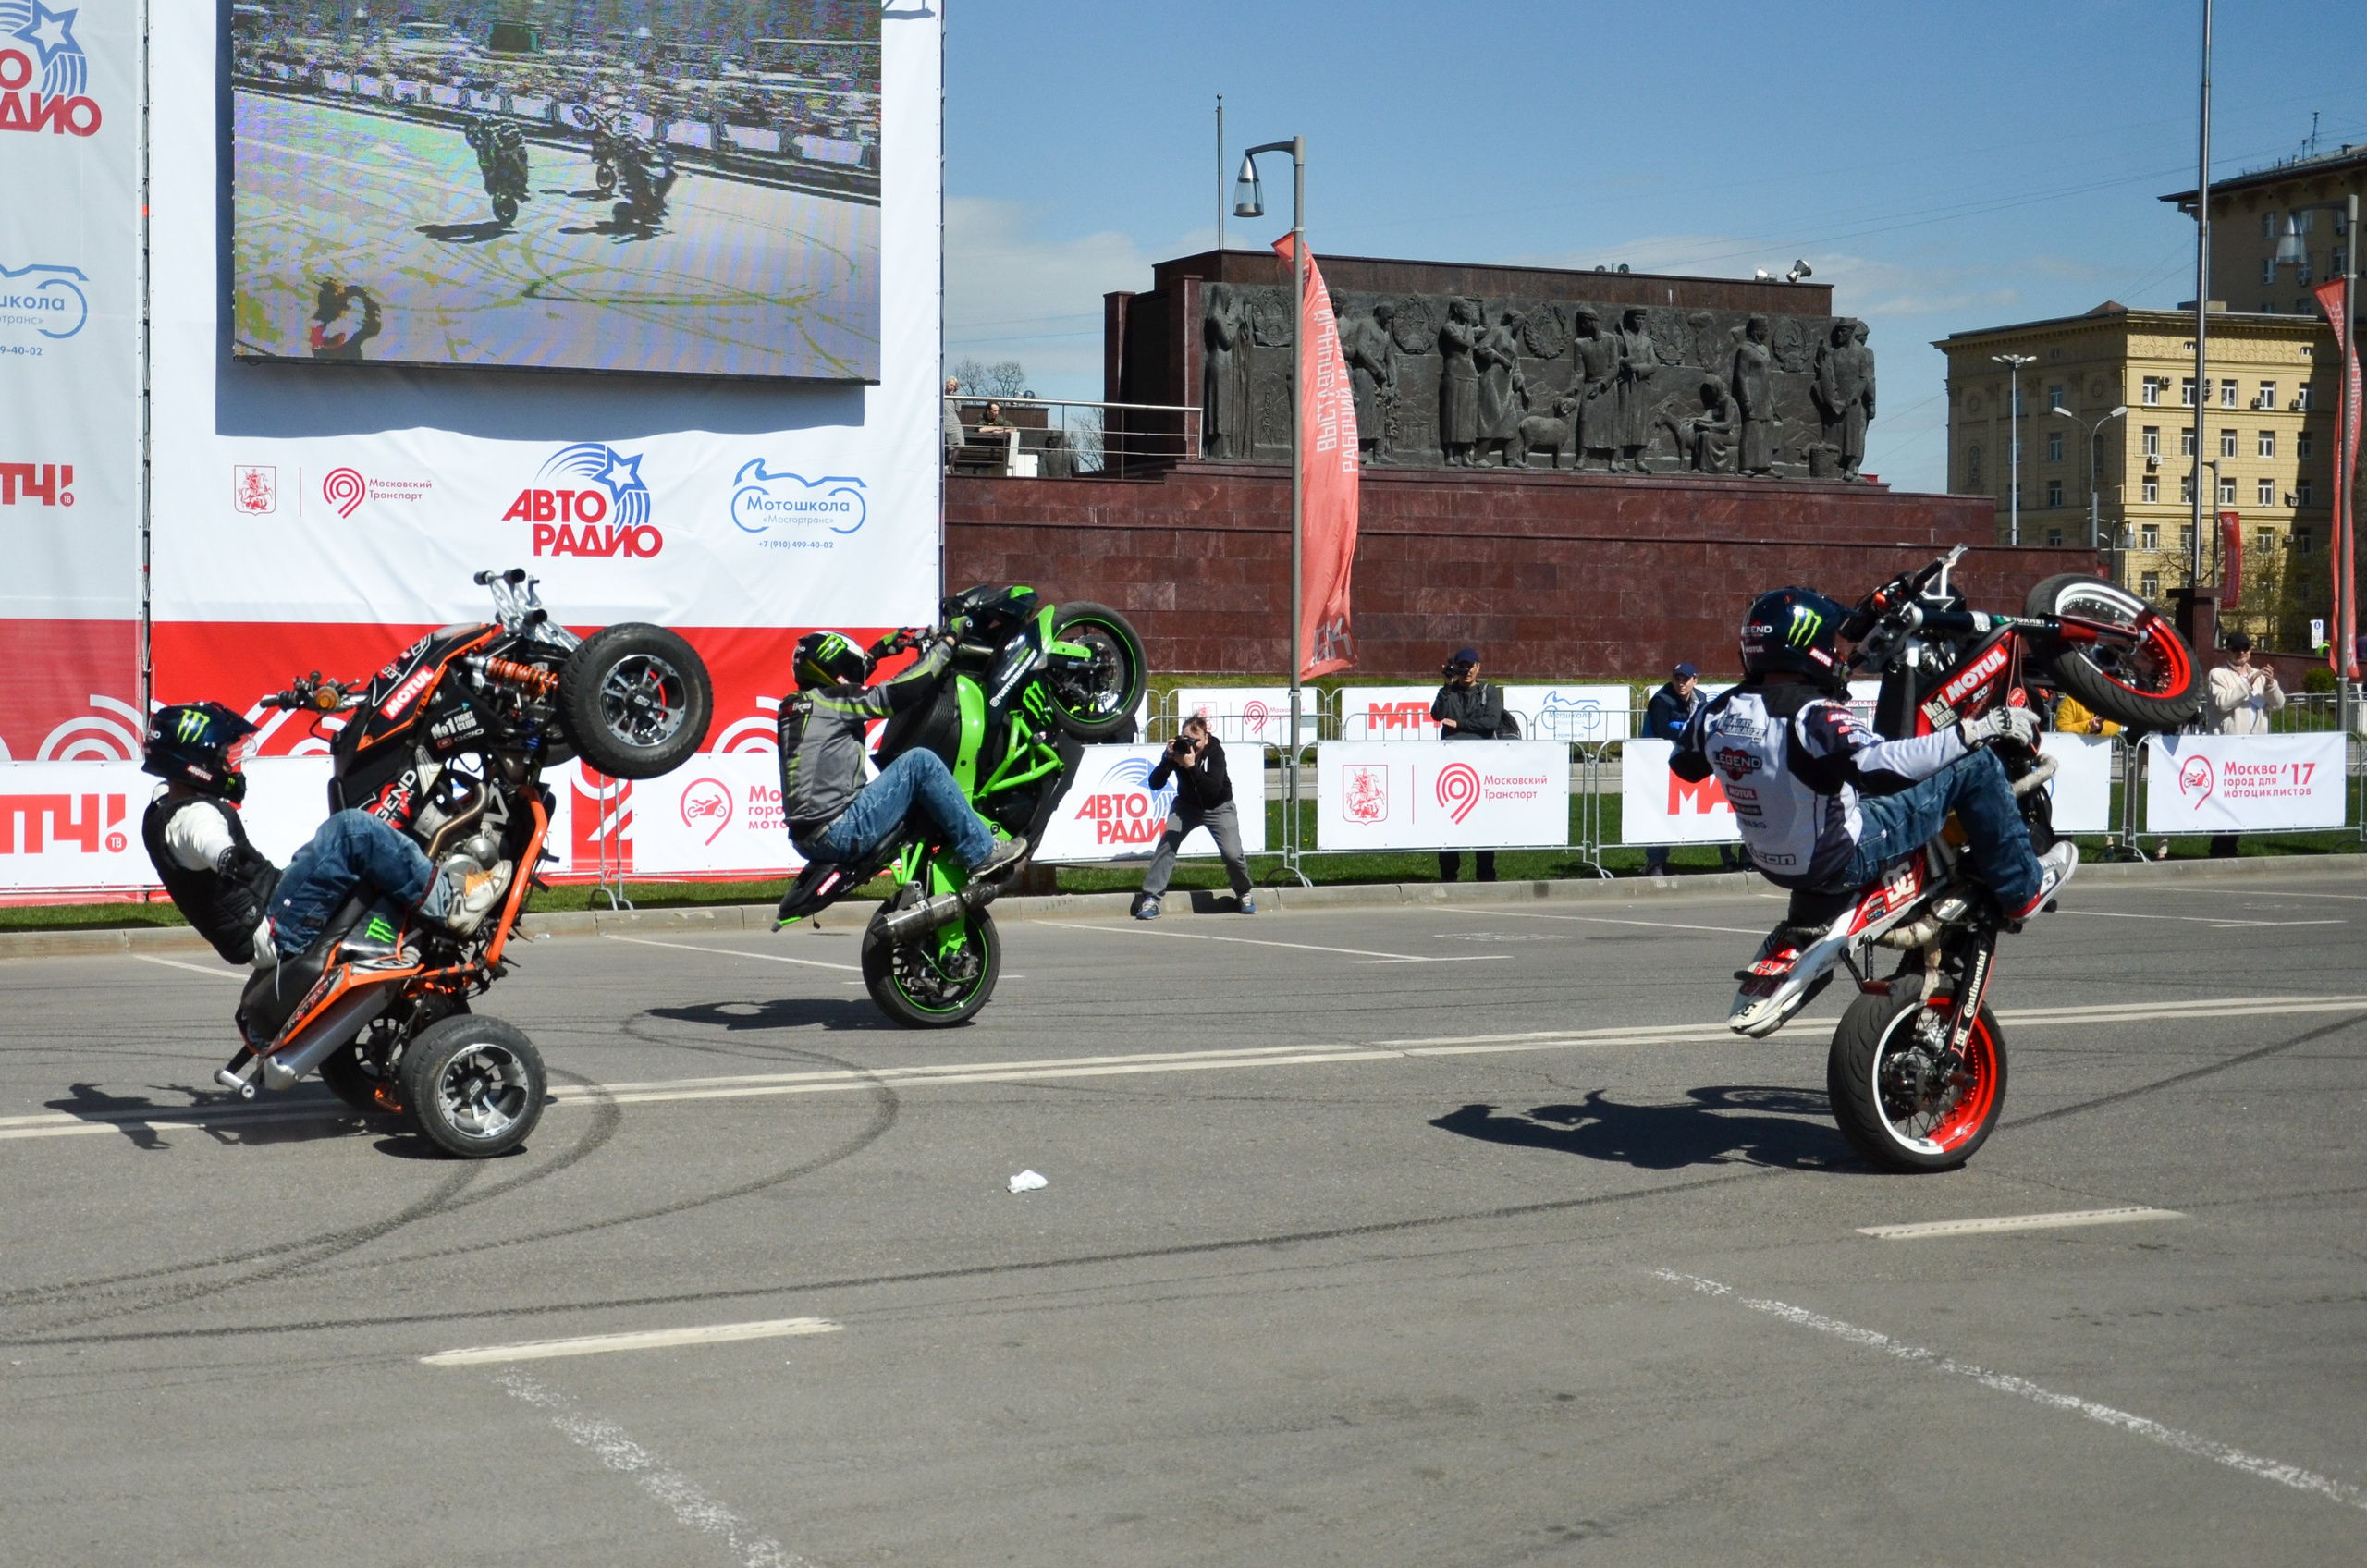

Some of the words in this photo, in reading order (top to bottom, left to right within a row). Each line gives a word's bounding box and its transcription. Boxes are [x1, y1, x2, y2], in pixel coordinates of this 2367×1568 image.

[1314, 308, 1337, 452] ВЫСТАВОЧНЫЙ
[1335, 387, 1359, 472] РАБОЧИЙ
[369, 478, 433, 489] Московский
[369, 490, 423, 502] Транспорт
[746, 496, 850, 512] Мотошкола
[501, 489, 607, 523] АВТО
[763, 514, 834, 526] «Мосгортранс»
[533, 523, 663, 558] РАДИО
[770, 540, 791, 549] (910)
[791, 540, 834, 549] 499-40-02
[1809, 648, 1833, 667] MOTUL
[1945, 650, 2006, 703] MOTUL
[385, 669, 435, 717] MOTUL
[457, 718, 477, 731] CLUB
[1714, 752, 1761, 769] LEGEND
[2224, 761, 2277, 776] Москва
[1484, 775, 1548, 785] Московский
[2223, 778, 2254, 789] город
[2258, 778, 2276, 787] для
[374, 769, 417, 821] GEND
[1484, 789, 1537, 802] Транспорт
[2224, 788, 2312, 798] мотоциклистов
[1074, 793, 1148, 820] АВТО
[1964, 949, 1987, 1018] Continental
